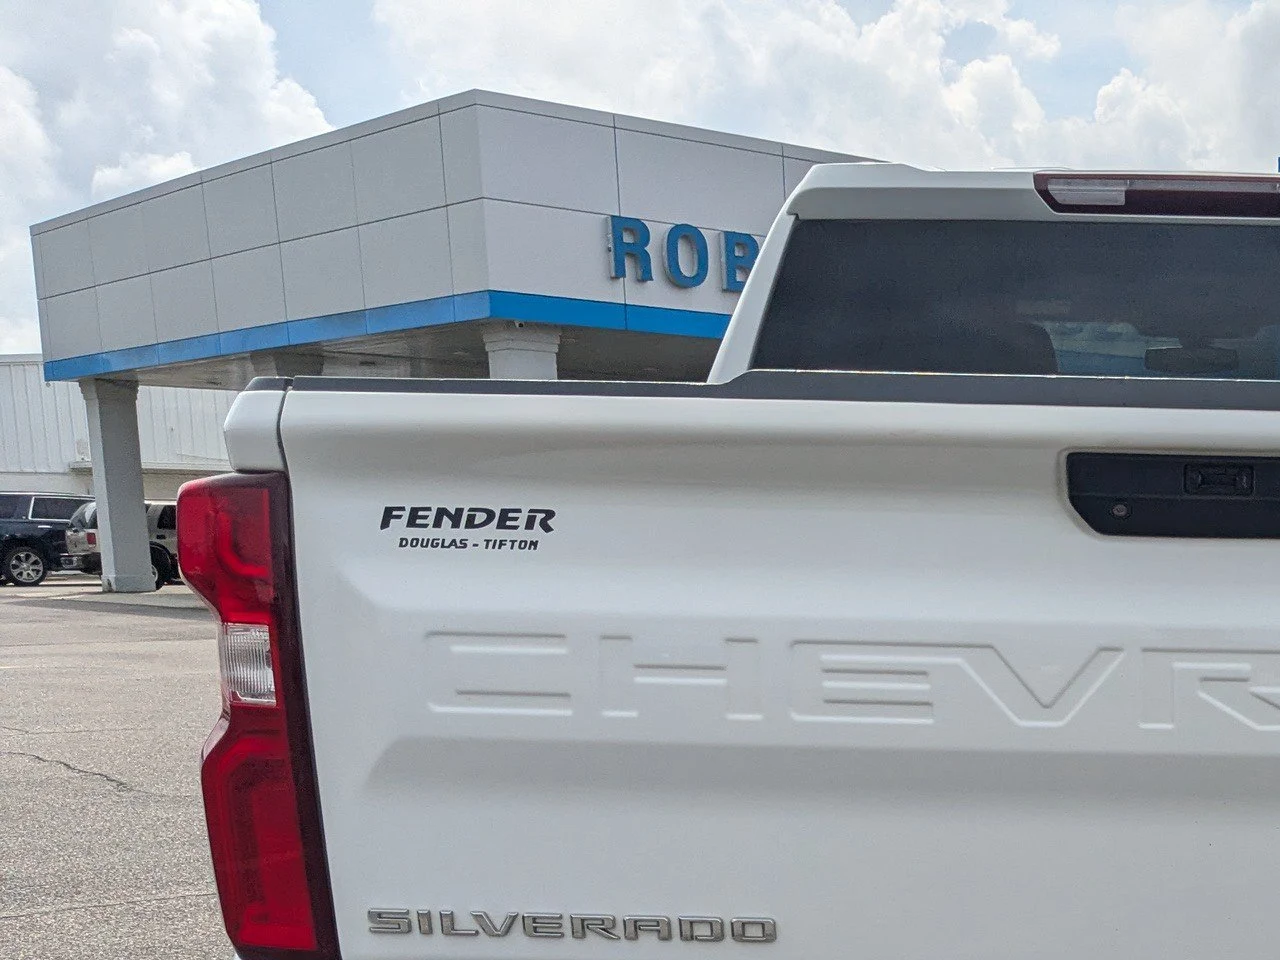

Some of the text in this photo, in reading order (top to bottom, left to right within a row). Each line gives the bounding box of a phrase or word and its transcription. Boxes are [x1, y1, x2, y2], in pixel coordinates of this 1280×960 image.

[609, 214, 759, 292] ROB
[380, 506, 556, 533] FENDER
[399, 538, 468, 549] DOUGLAS
[484, 539, 539, 550] TIFTON
[367, 908, 777, 943] SILVERADO
